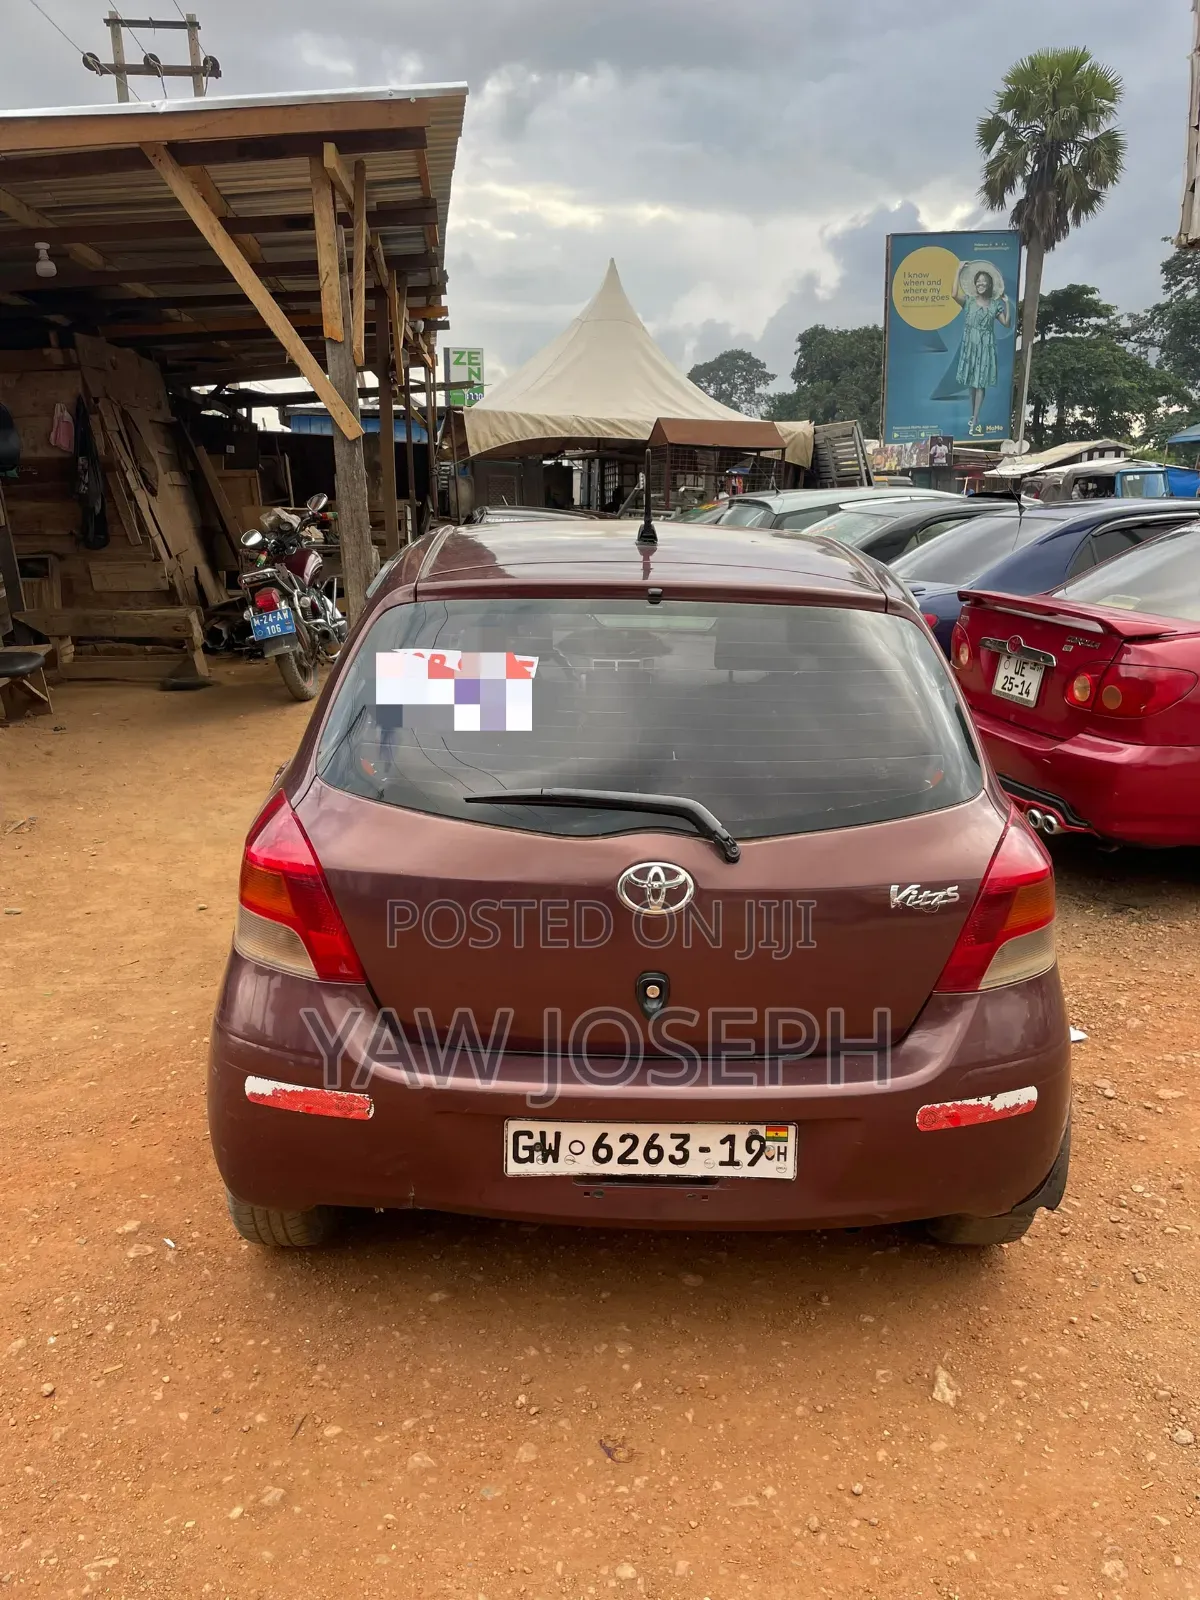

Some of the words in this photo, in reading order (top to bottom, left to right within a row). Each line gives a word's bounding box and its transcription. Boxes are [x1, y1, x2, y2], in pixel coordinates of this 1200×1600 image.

[926, 278, 942, 286] and
[903, 295, 930, 303] money
[930, 294, 950, 303] goes
[929, 287, 941, 295] my
[452, 350, 481, 366] ZE
[468, 366, 481, 382] N
[266, 624, 282, 636] 106
[1014, 659, 1030, 678] UE
[1001, 675, 1032, 698] 25-14
[512, 1130, 562, 1164] GW
[591, 1132, 767, 1167] 6263-19
